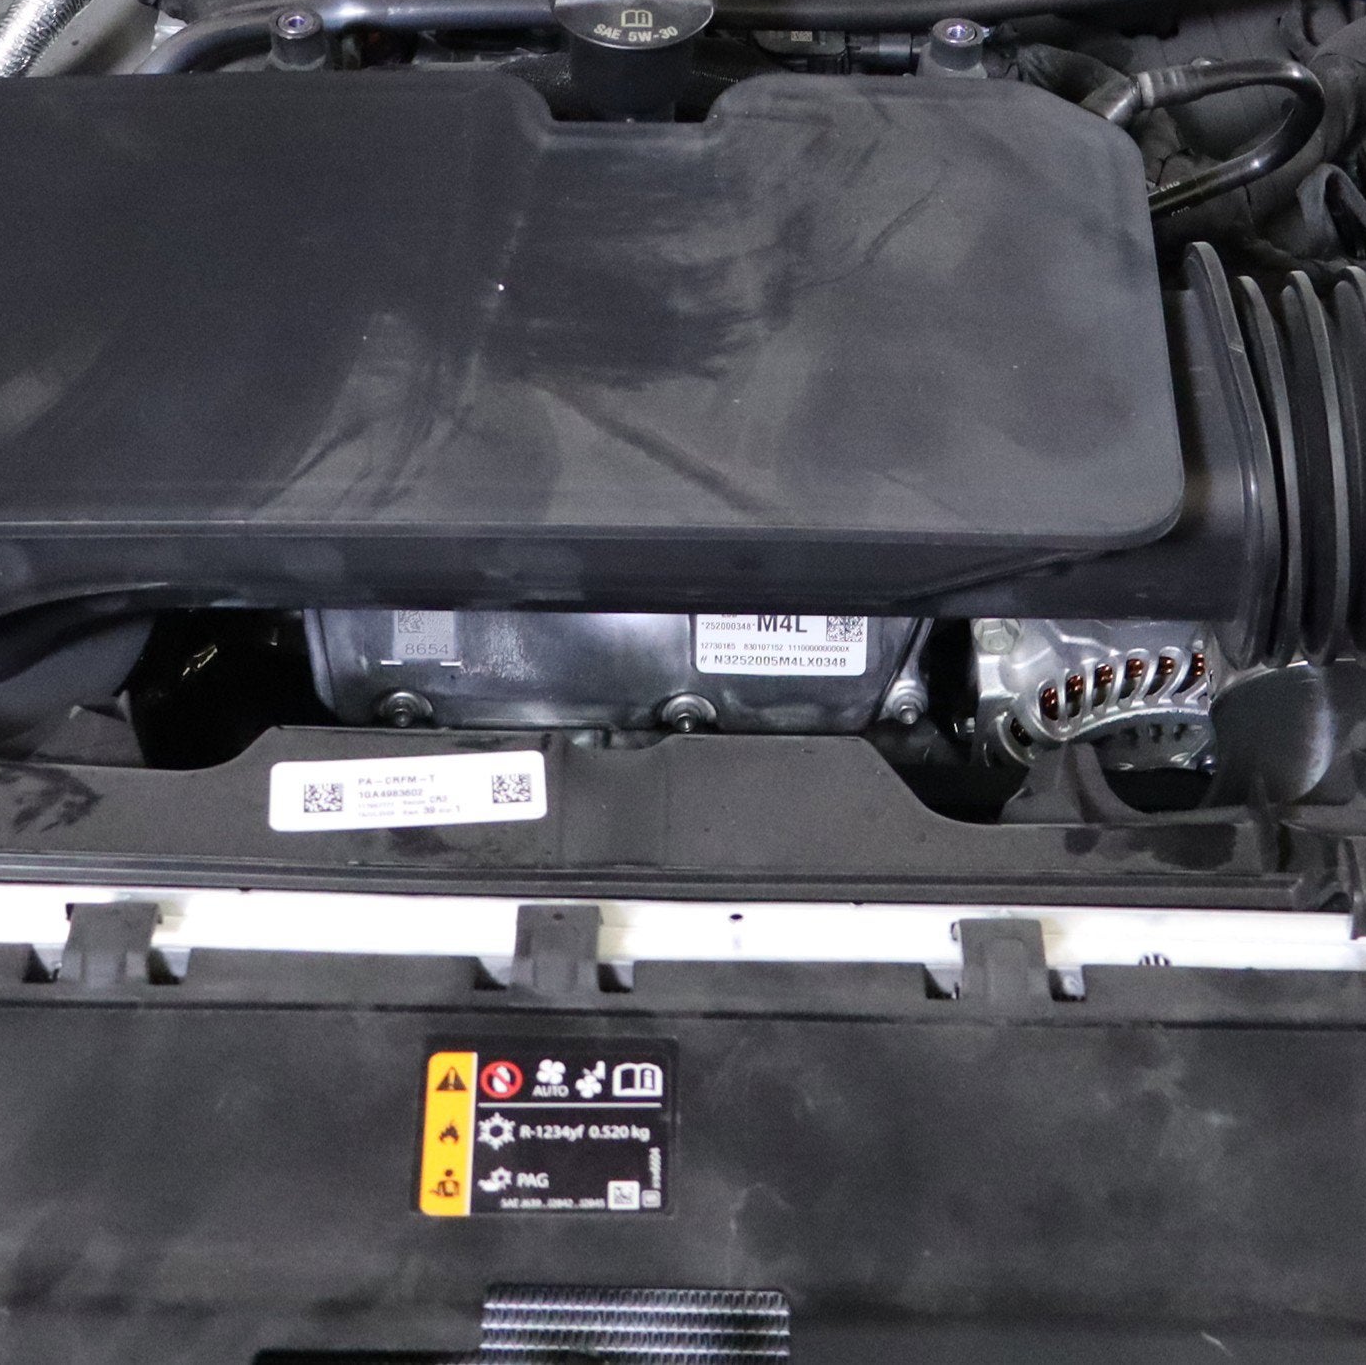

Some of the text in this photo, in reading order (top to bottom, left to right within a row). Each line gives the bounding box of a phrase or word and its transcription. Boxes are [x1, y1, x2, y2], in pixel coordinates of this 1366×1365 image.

[594, 24, 678, 42] SAE 5W-30
[757, 614, 807, 633] M4L
[404, 643, 449, 655] 8654
[532, 1085, 569, 1098] AUTO
[519, 1124, 651, 1142] R-1234yf 0.520 kg
[516, 1172, 549, 1188] PAG
